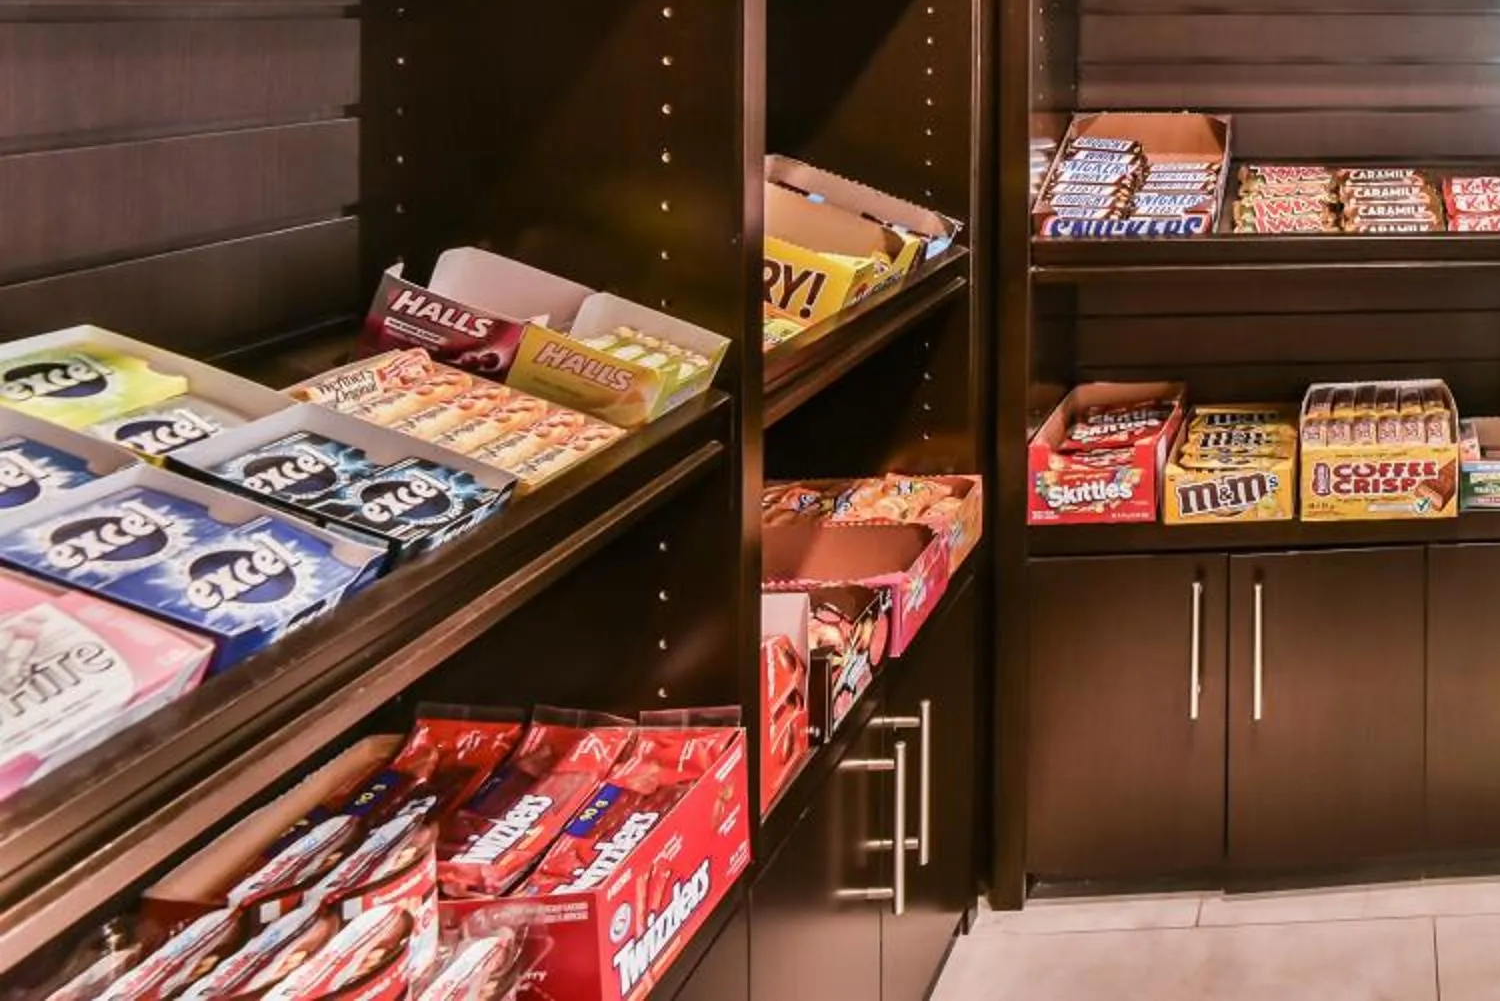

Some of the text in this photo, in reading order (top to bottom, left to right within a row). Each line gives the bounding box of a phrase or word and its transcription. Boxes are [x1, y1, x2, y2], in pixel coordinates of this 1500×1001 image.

[1350, 168, 1416, 181] CARAMILK
[1355, 186, 1422, 199] CARAMILK
[1358, 204, 1427, 217] CARAMILK
[390, 290, 495, 339] HALLS
[1, 353, 114, 402] excel
[536, 342, 635, 393] HALLS
[120, 408, 221, 456] xcel
[243, 444, 341, 498] excel
[1047, 480, 1134, 508] Skittles
[1331, 477, 1418, 494] CRISP
[1332, 461, 1438, 479] COFFEE
[361, 470, 451, 525] excel
[46, 500, 175, 570] excel
[186, 531, 303, 611] excel
[612, 857, 712, 997] Twizzlers
